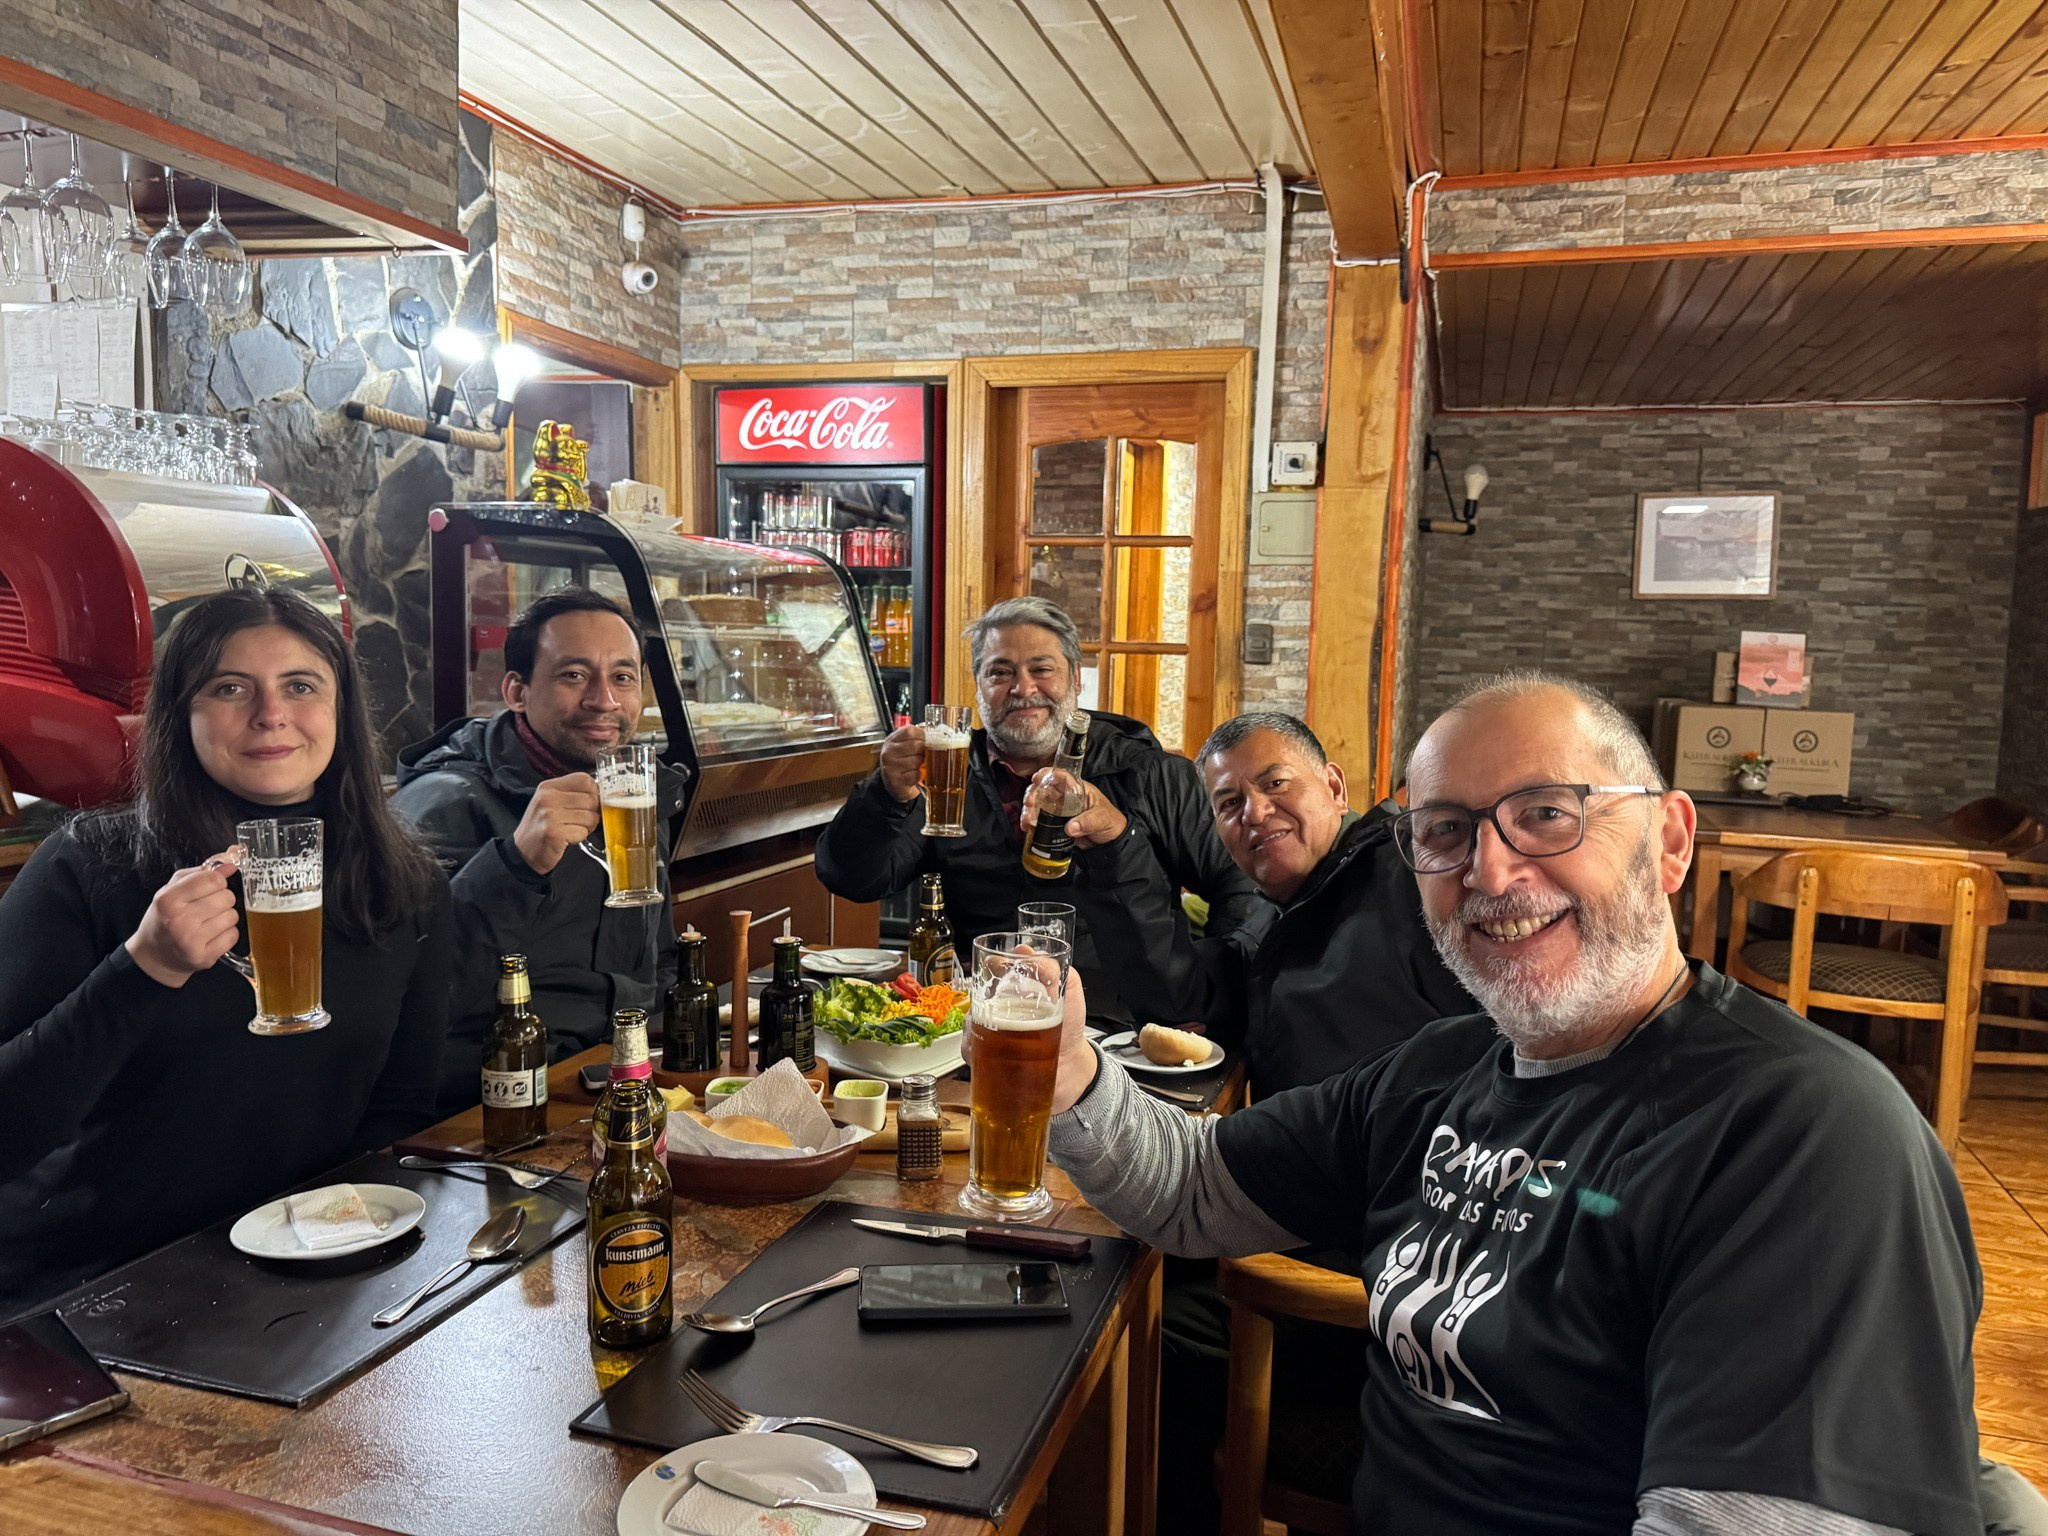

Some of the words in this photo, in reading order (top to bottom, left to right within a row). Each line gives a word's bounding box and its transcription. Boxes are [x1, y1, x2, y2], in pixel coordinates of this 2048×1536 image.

[739, 396, 897, 450] Coca-Cola
[262, 864, 321, 891] AUSTRAL
[1425, 1184, 1457, 1212] POR
[1458, 1200, 1485, 1224] LAS
[610, 1223, 636, 1239] CERVEZA
[605, 1240, 665, 1261] kunstmann
[619, 1269, 656, 1297] Miel
[613, 1308, 641, 1319] VALDIVIA
